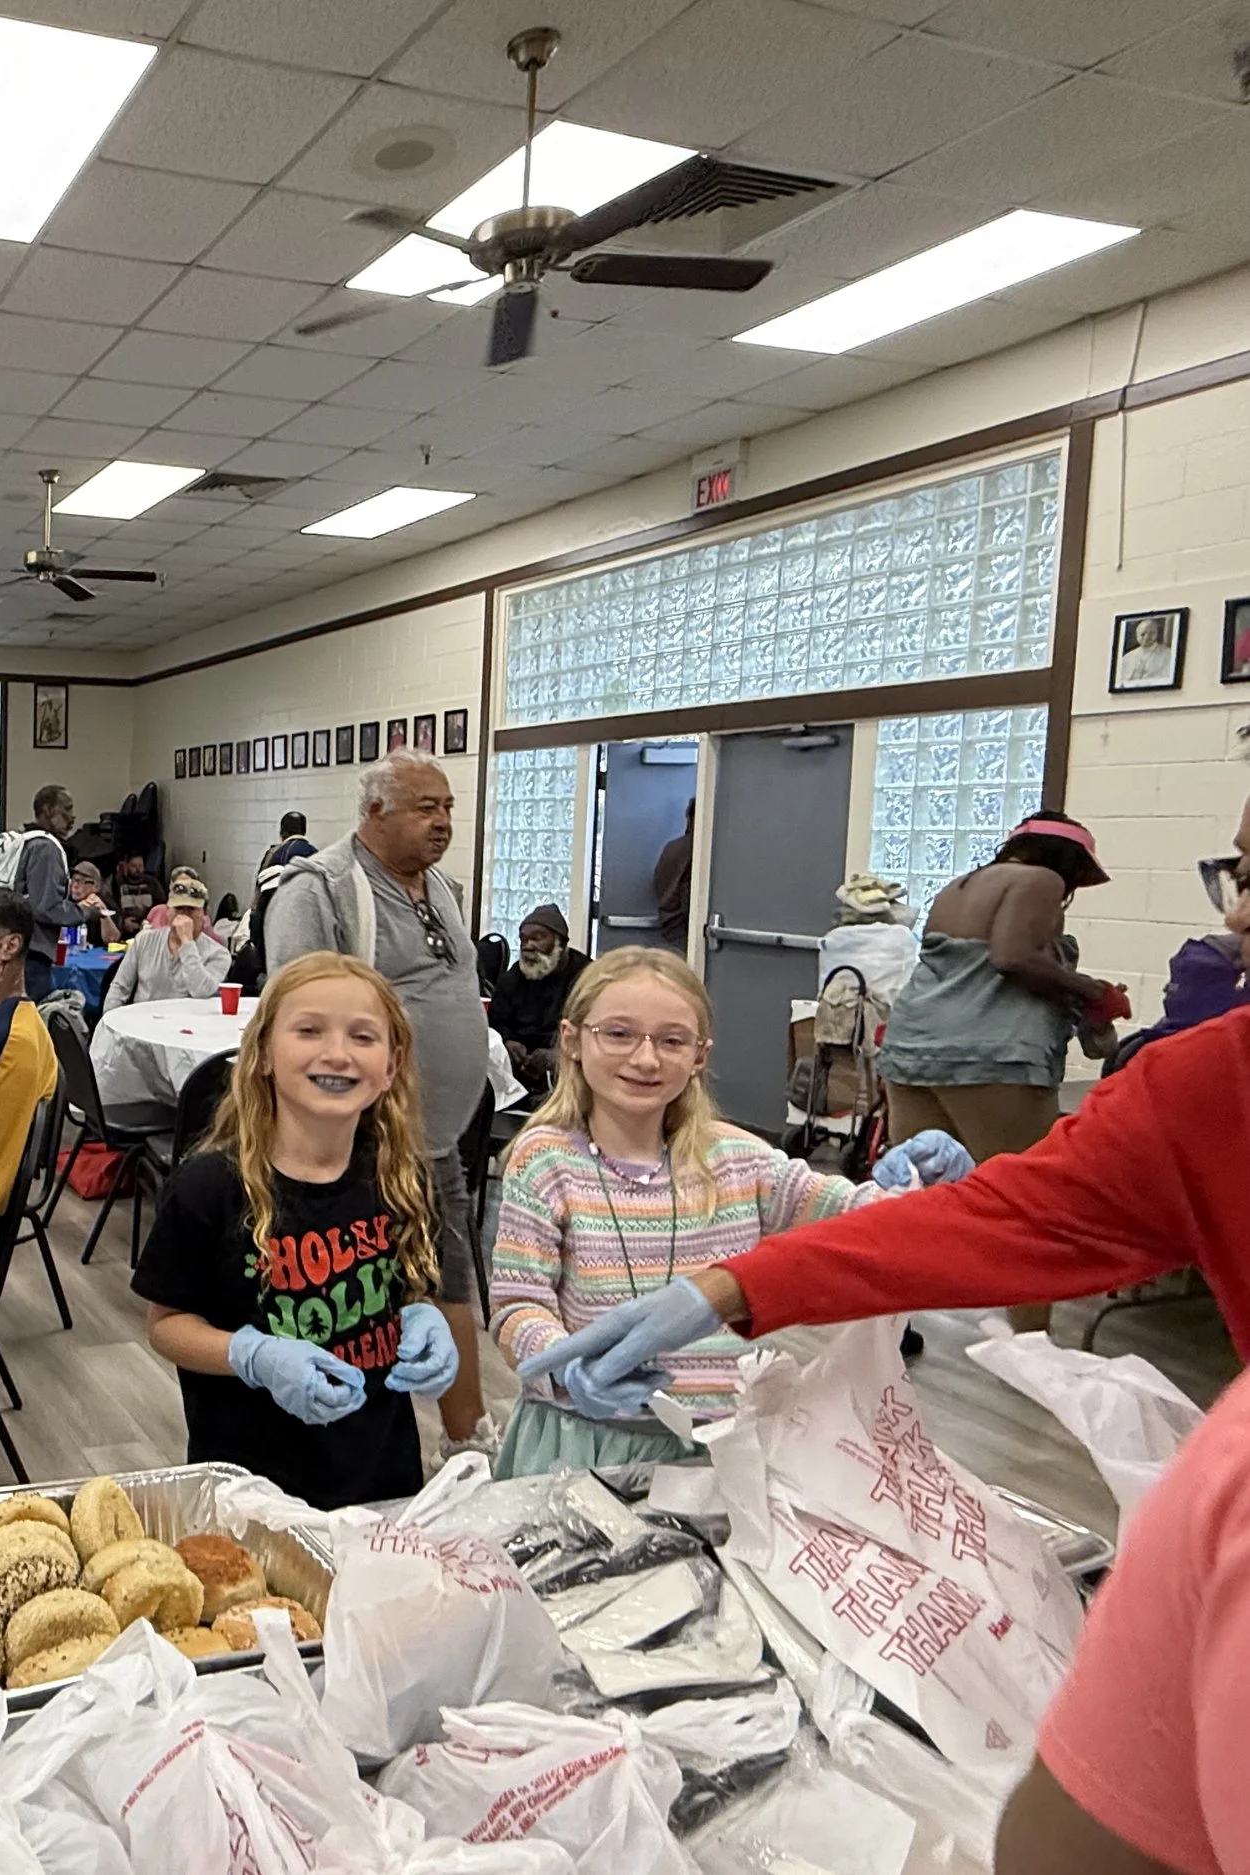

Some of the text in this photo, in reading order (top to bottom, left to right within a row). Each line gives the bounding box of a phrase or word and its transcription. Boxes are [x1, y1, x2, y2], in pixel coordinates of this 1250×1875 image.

[696, 468, 732, 508] EXIT
[268, 1214, 390, 1290] HOLLY
[267, 1257, 400, 1344] JOLLY
